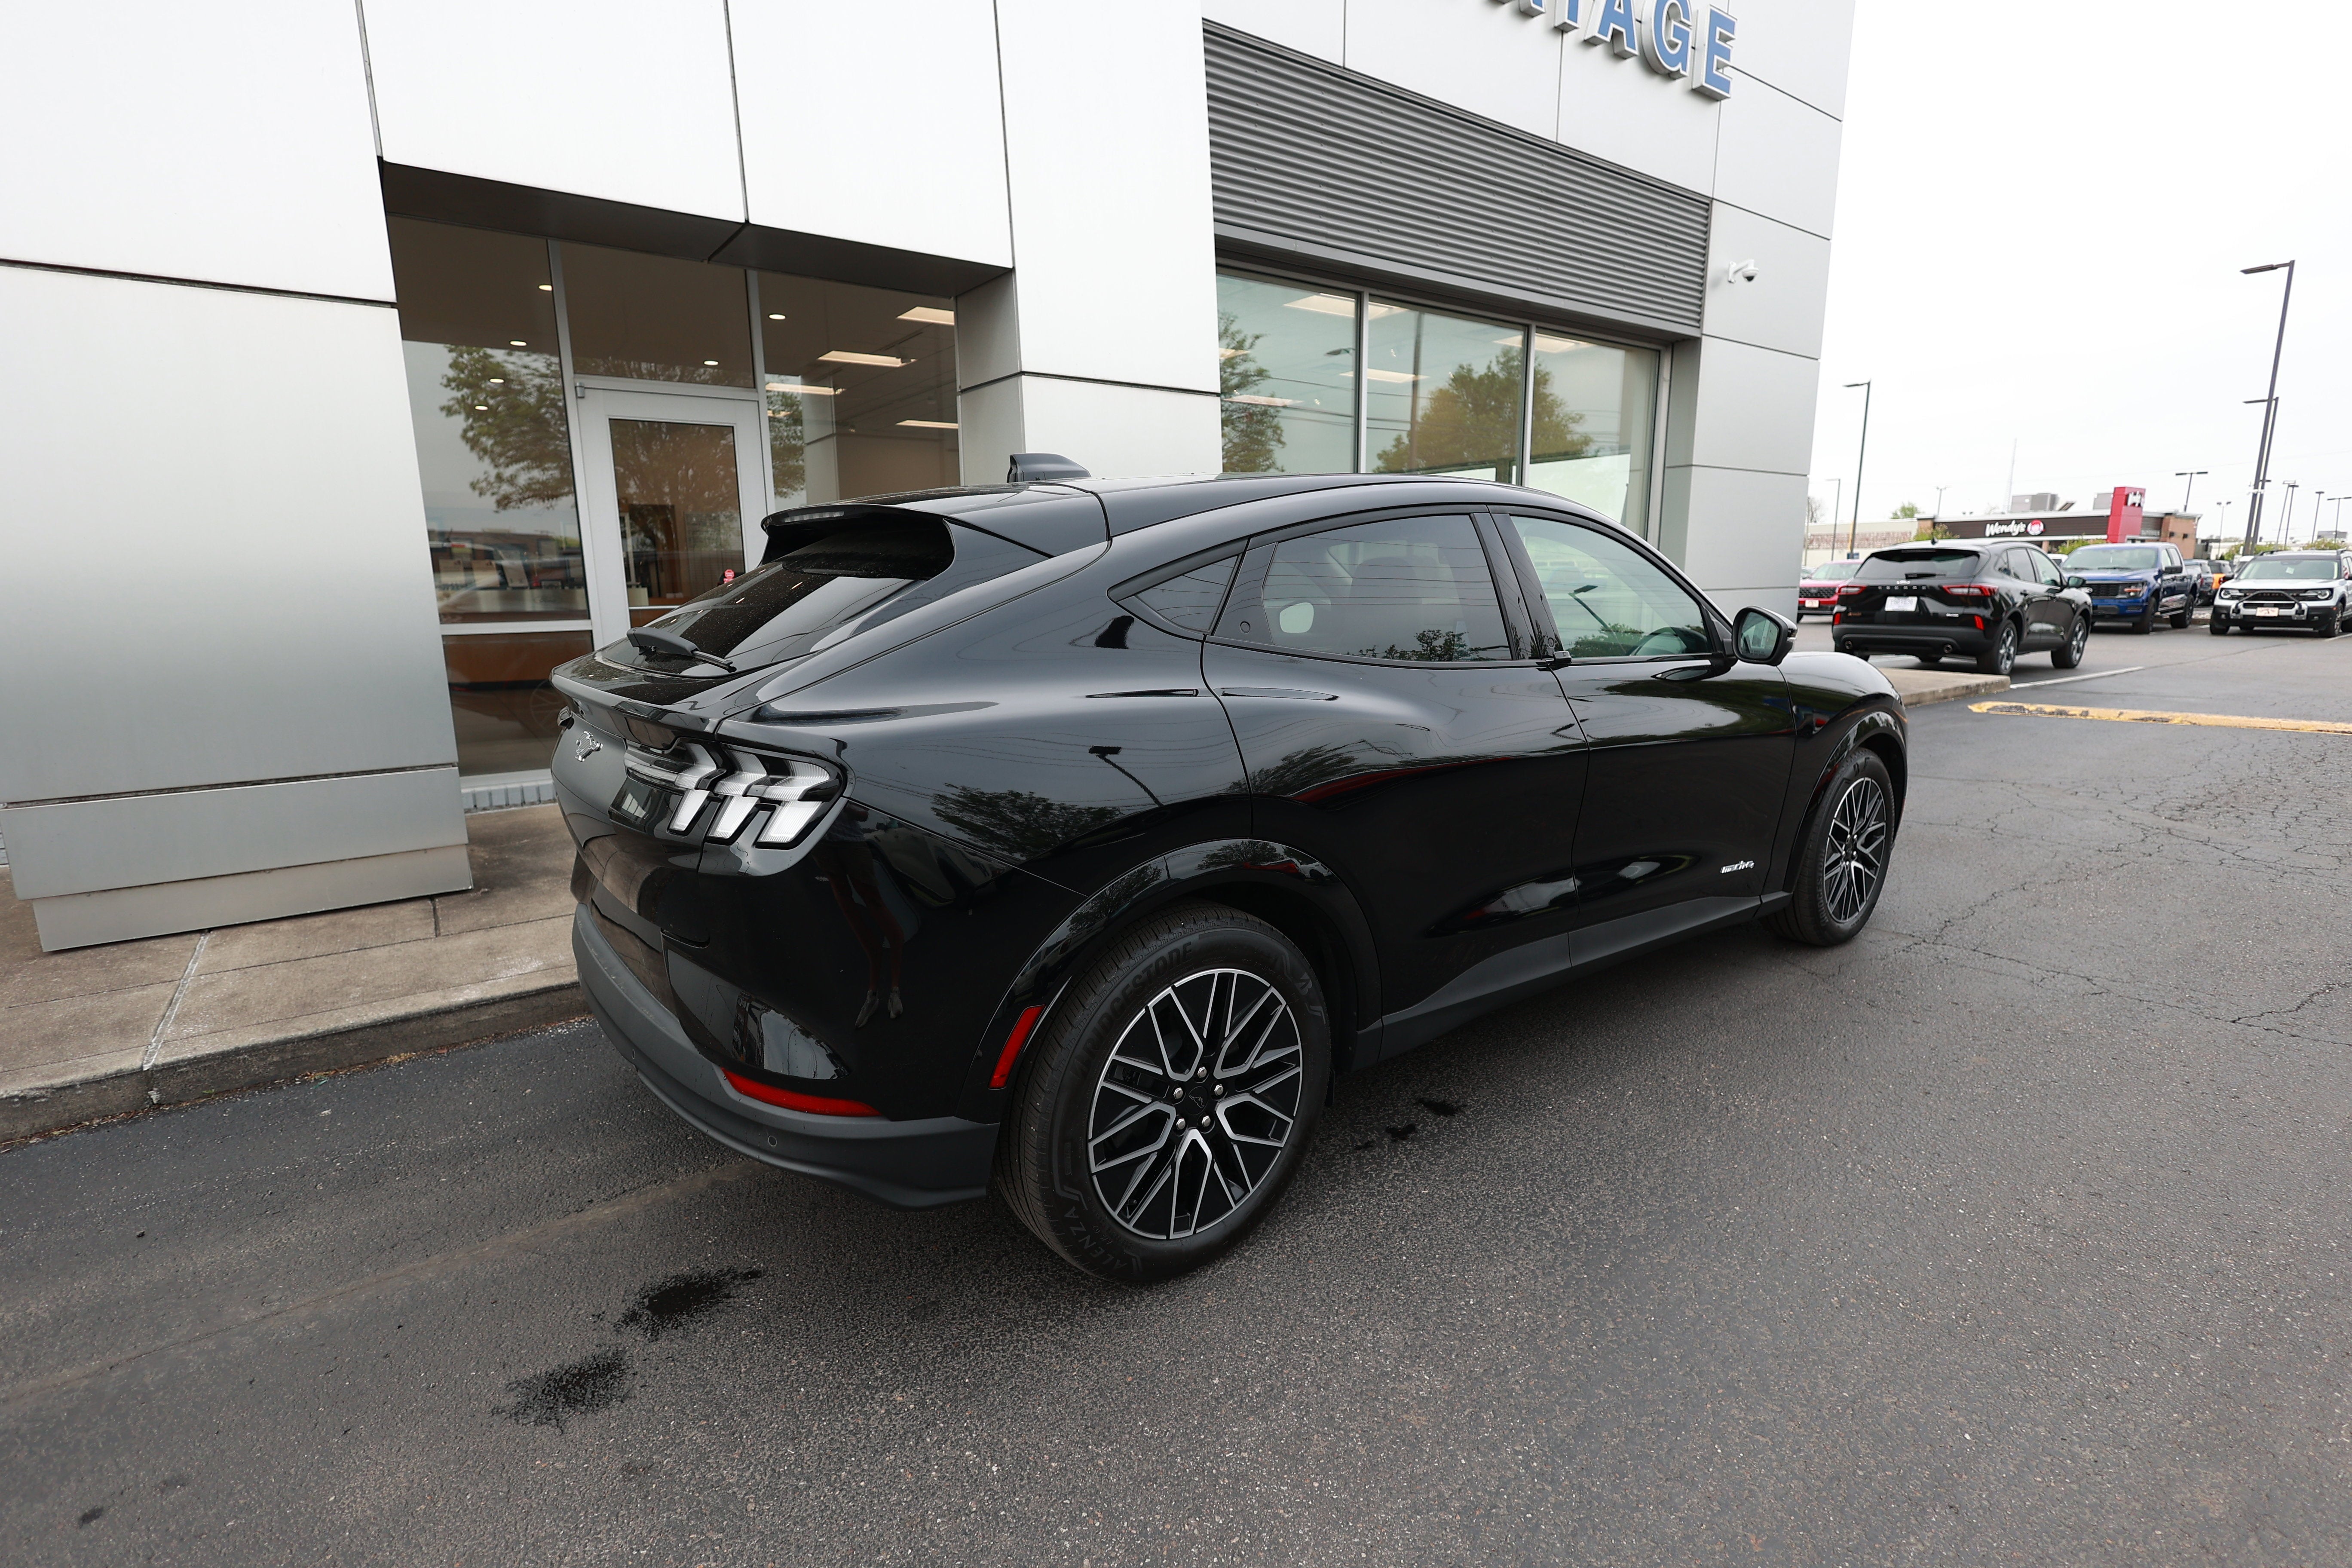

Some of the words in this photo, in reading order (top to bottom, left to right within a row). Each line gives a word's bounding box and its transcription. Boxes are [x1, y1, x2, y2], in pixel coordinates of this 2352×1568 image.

[1985, 520, 2026, 537] Wendy's
[1069, 941, 1192, 1079] BRIDGESTONE
[1064, 1206, 1128, 1270] ALENZA
